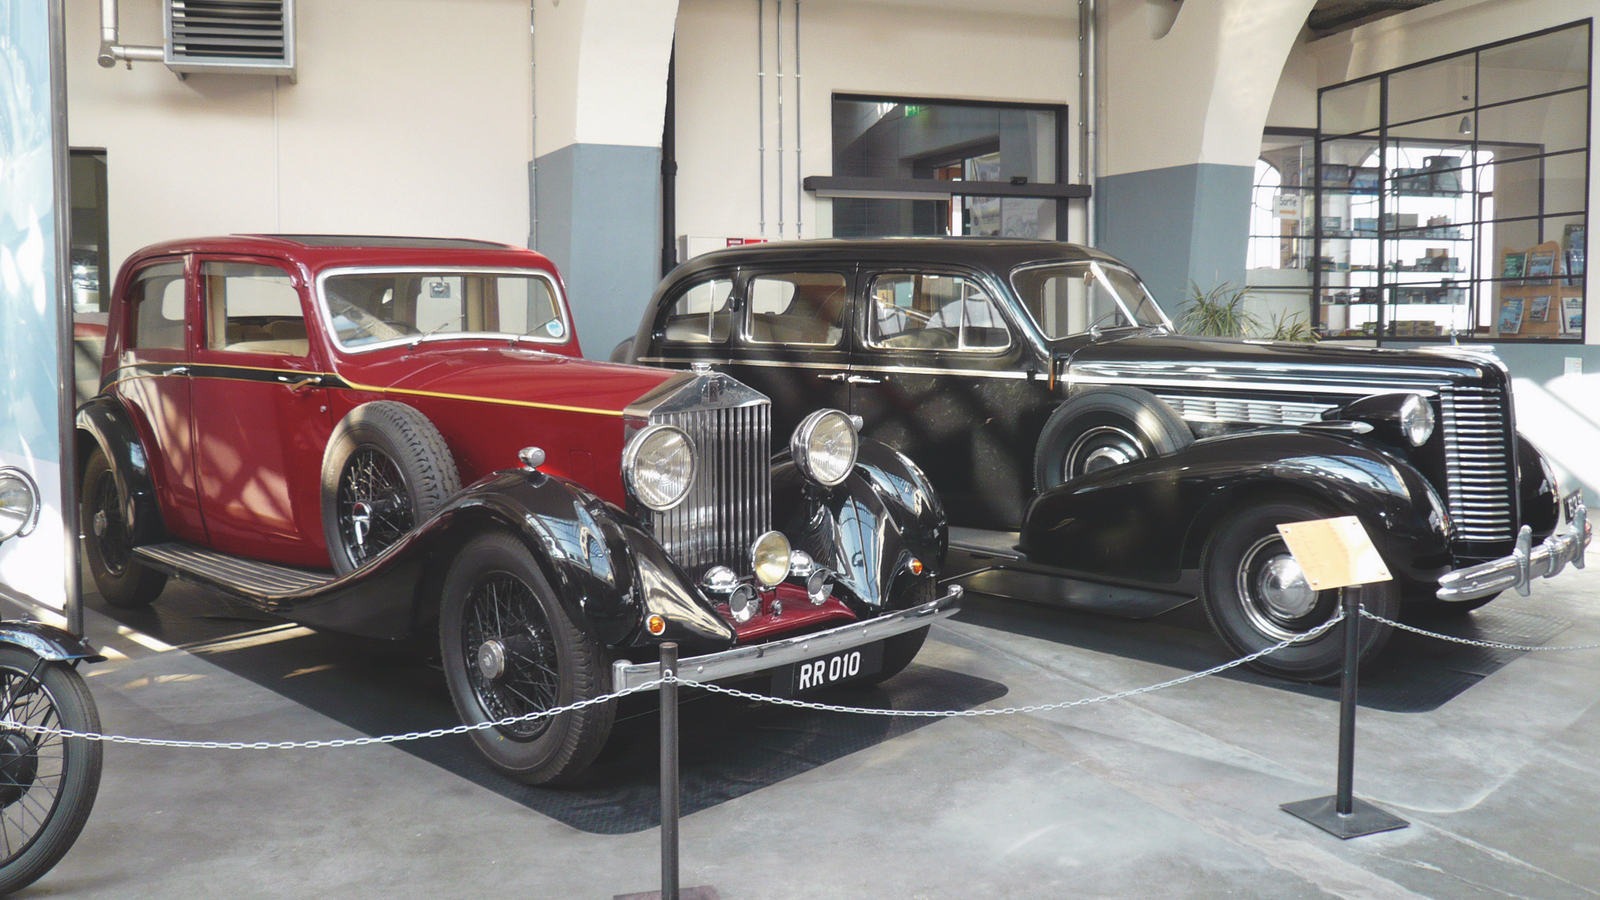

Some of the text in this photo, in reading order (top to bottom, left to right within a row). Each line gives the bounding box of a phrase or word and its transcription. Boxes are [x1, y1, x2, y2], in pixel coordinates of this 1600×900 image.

[1279, 196, 1297, 207] Sortie
[799, 651, 861, 690] RR 010
